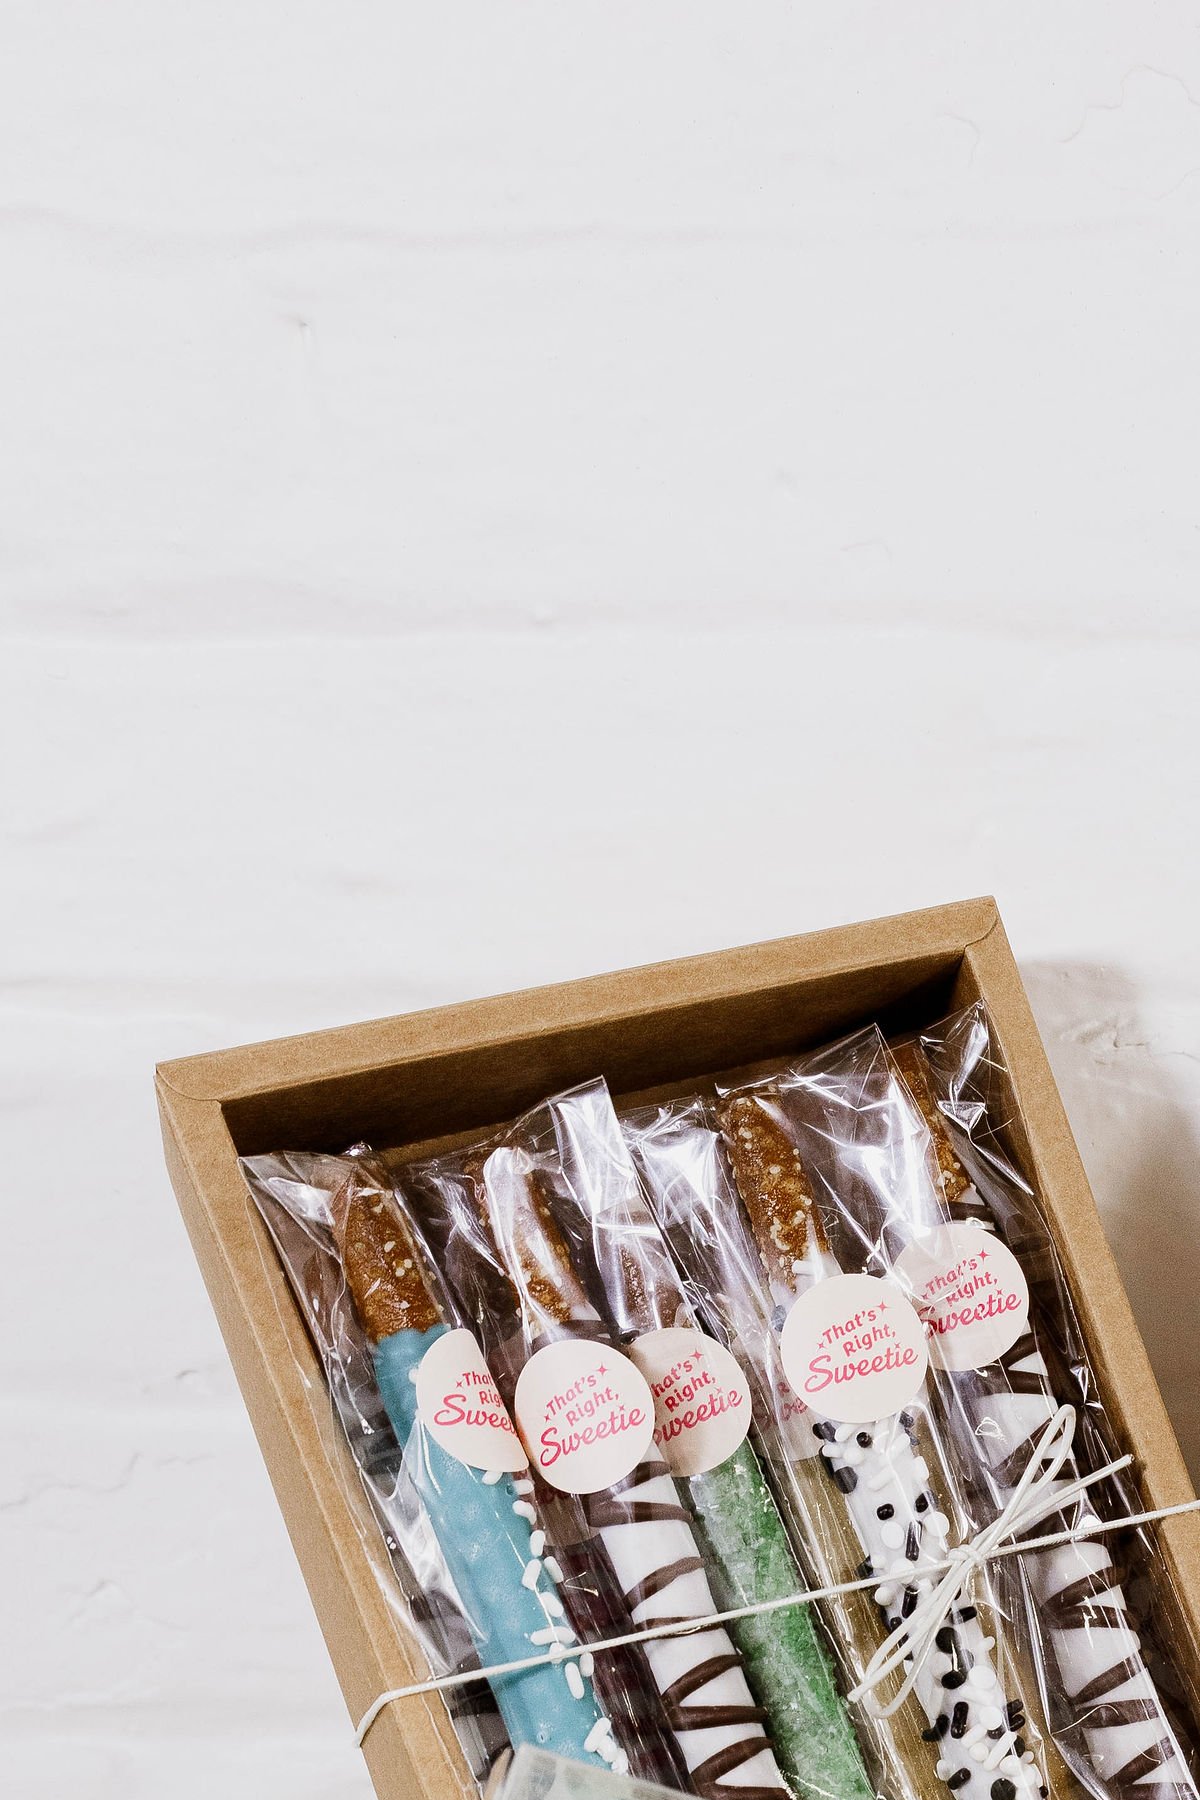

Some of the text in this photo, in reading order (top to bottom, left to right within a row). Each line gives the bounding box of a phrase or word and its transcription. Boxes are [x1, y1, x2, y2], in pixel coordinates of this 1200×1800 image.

[925, 1258, 977, 1295] That's
[822, 1309, 876, 1344] That's
[842, 1323, 896, 1356] Right,
[651, 1359, 693, 1398] hat's
[804, 1347, 918, 1393] Sweetie
[546, 1374, 597, 1416] That's
[565, 1387, 619, 1427] Right,
[664, 1371, 716, 1413] Right,
[540, 1408, 646, 1467] Sweetie
